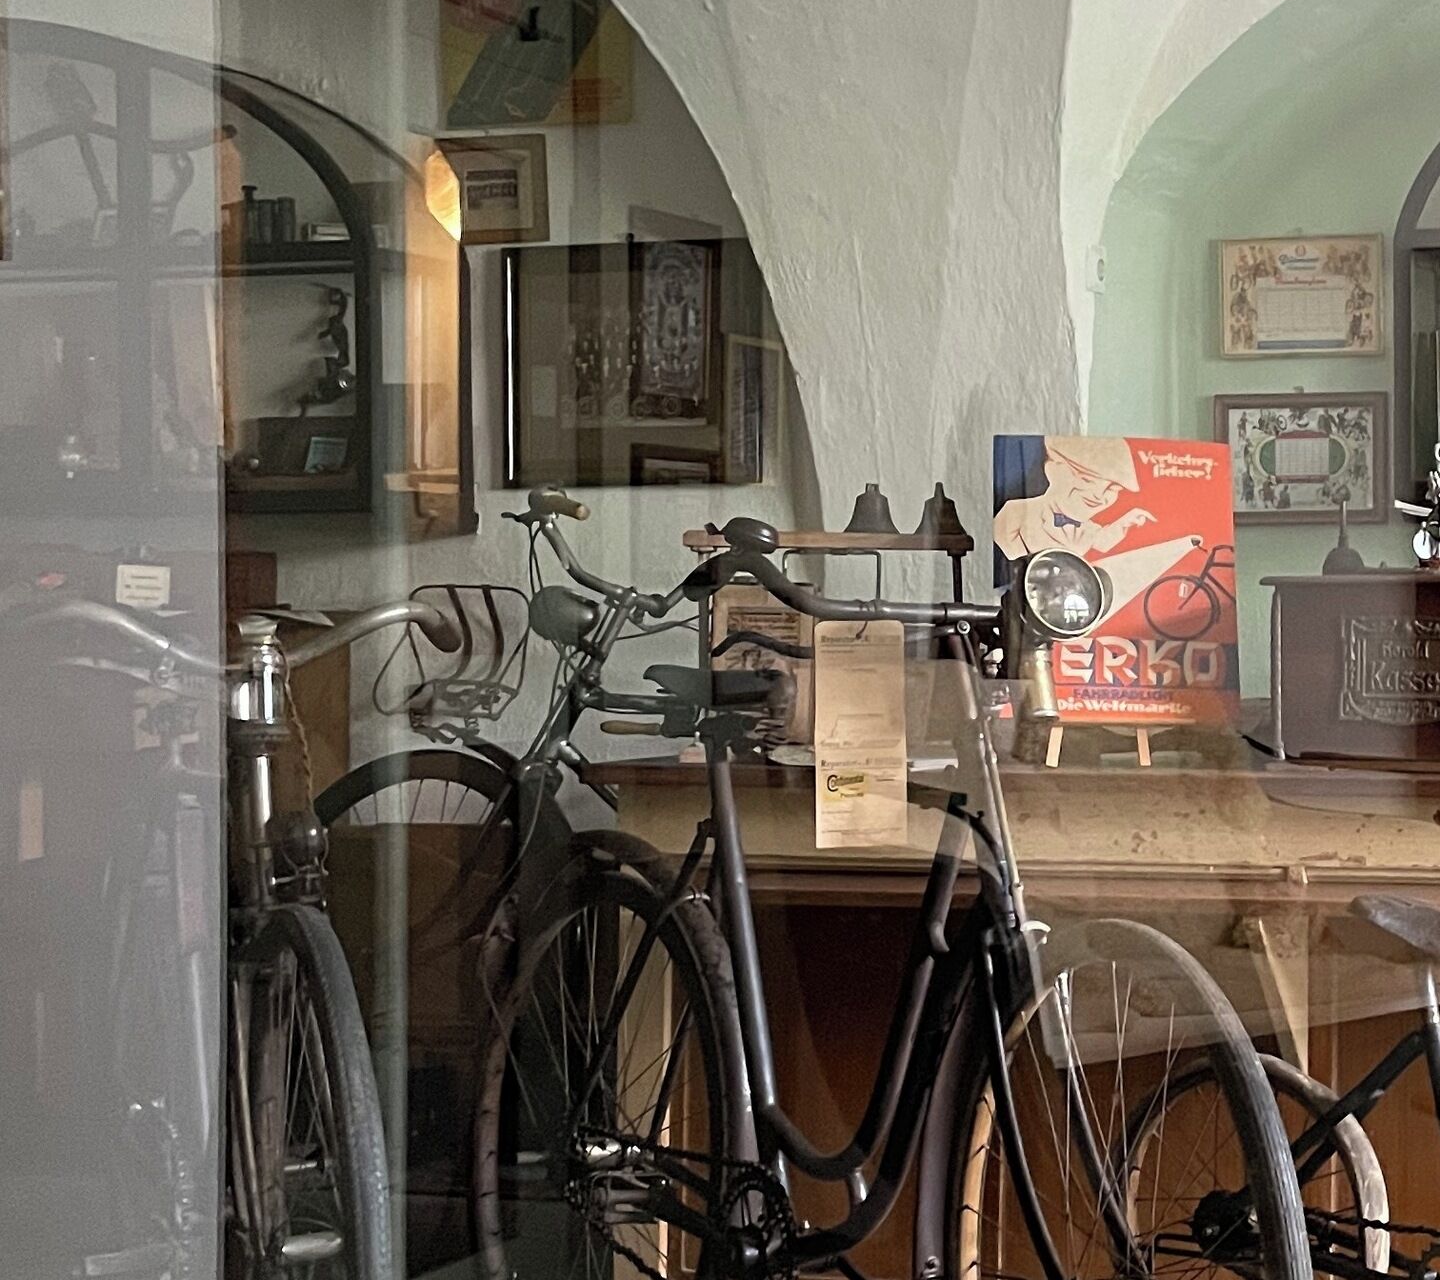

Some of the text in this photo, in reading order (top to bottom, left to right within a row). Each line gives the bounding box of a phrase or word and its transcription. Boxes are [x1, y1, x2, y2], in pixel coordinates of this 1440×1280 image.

[1052, 634, 1227, 687] ERKO
[1370, 660, 1440, 692] Kasse
[1058, 697, 1084, 712] Die
